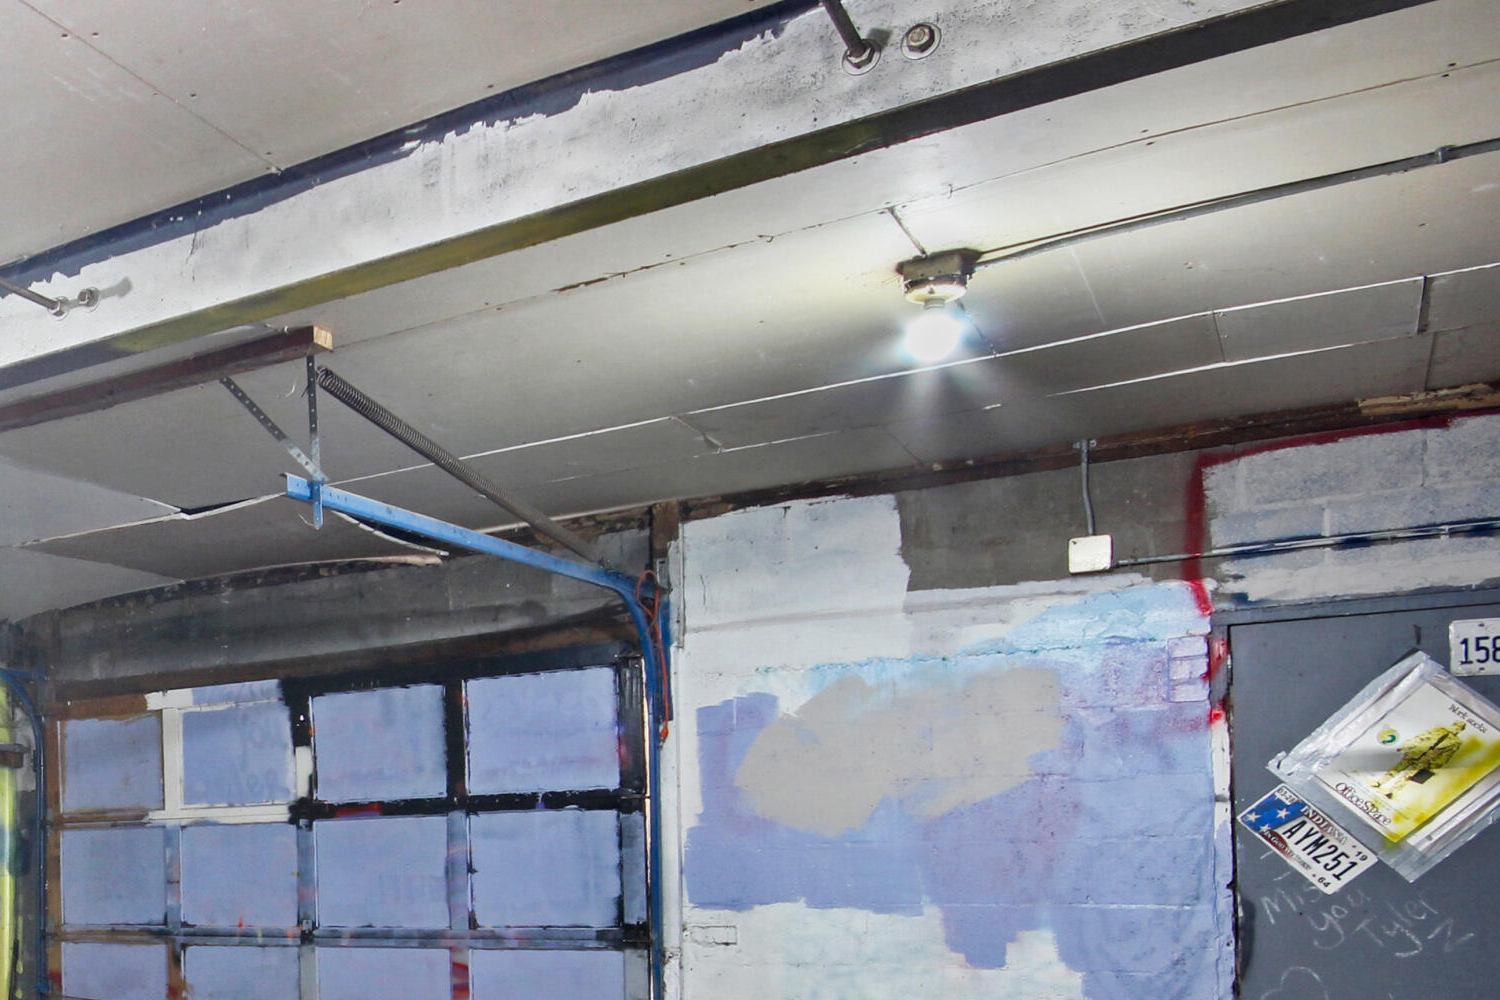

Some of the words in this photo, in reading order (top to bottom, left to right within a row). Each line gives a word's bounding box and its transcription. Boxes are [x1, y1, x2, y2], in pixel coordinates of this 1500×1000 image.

[1335, 782, 1364, 809] Office
[1301, 805, 1348, 845] INDIANA
[1283, 819, 1358, 881] AYM251
[1355, 850, 1369, 862] 19
[1317, 876, 1332, 888] 64
[1355, 892, 1439, 958] Tyler
